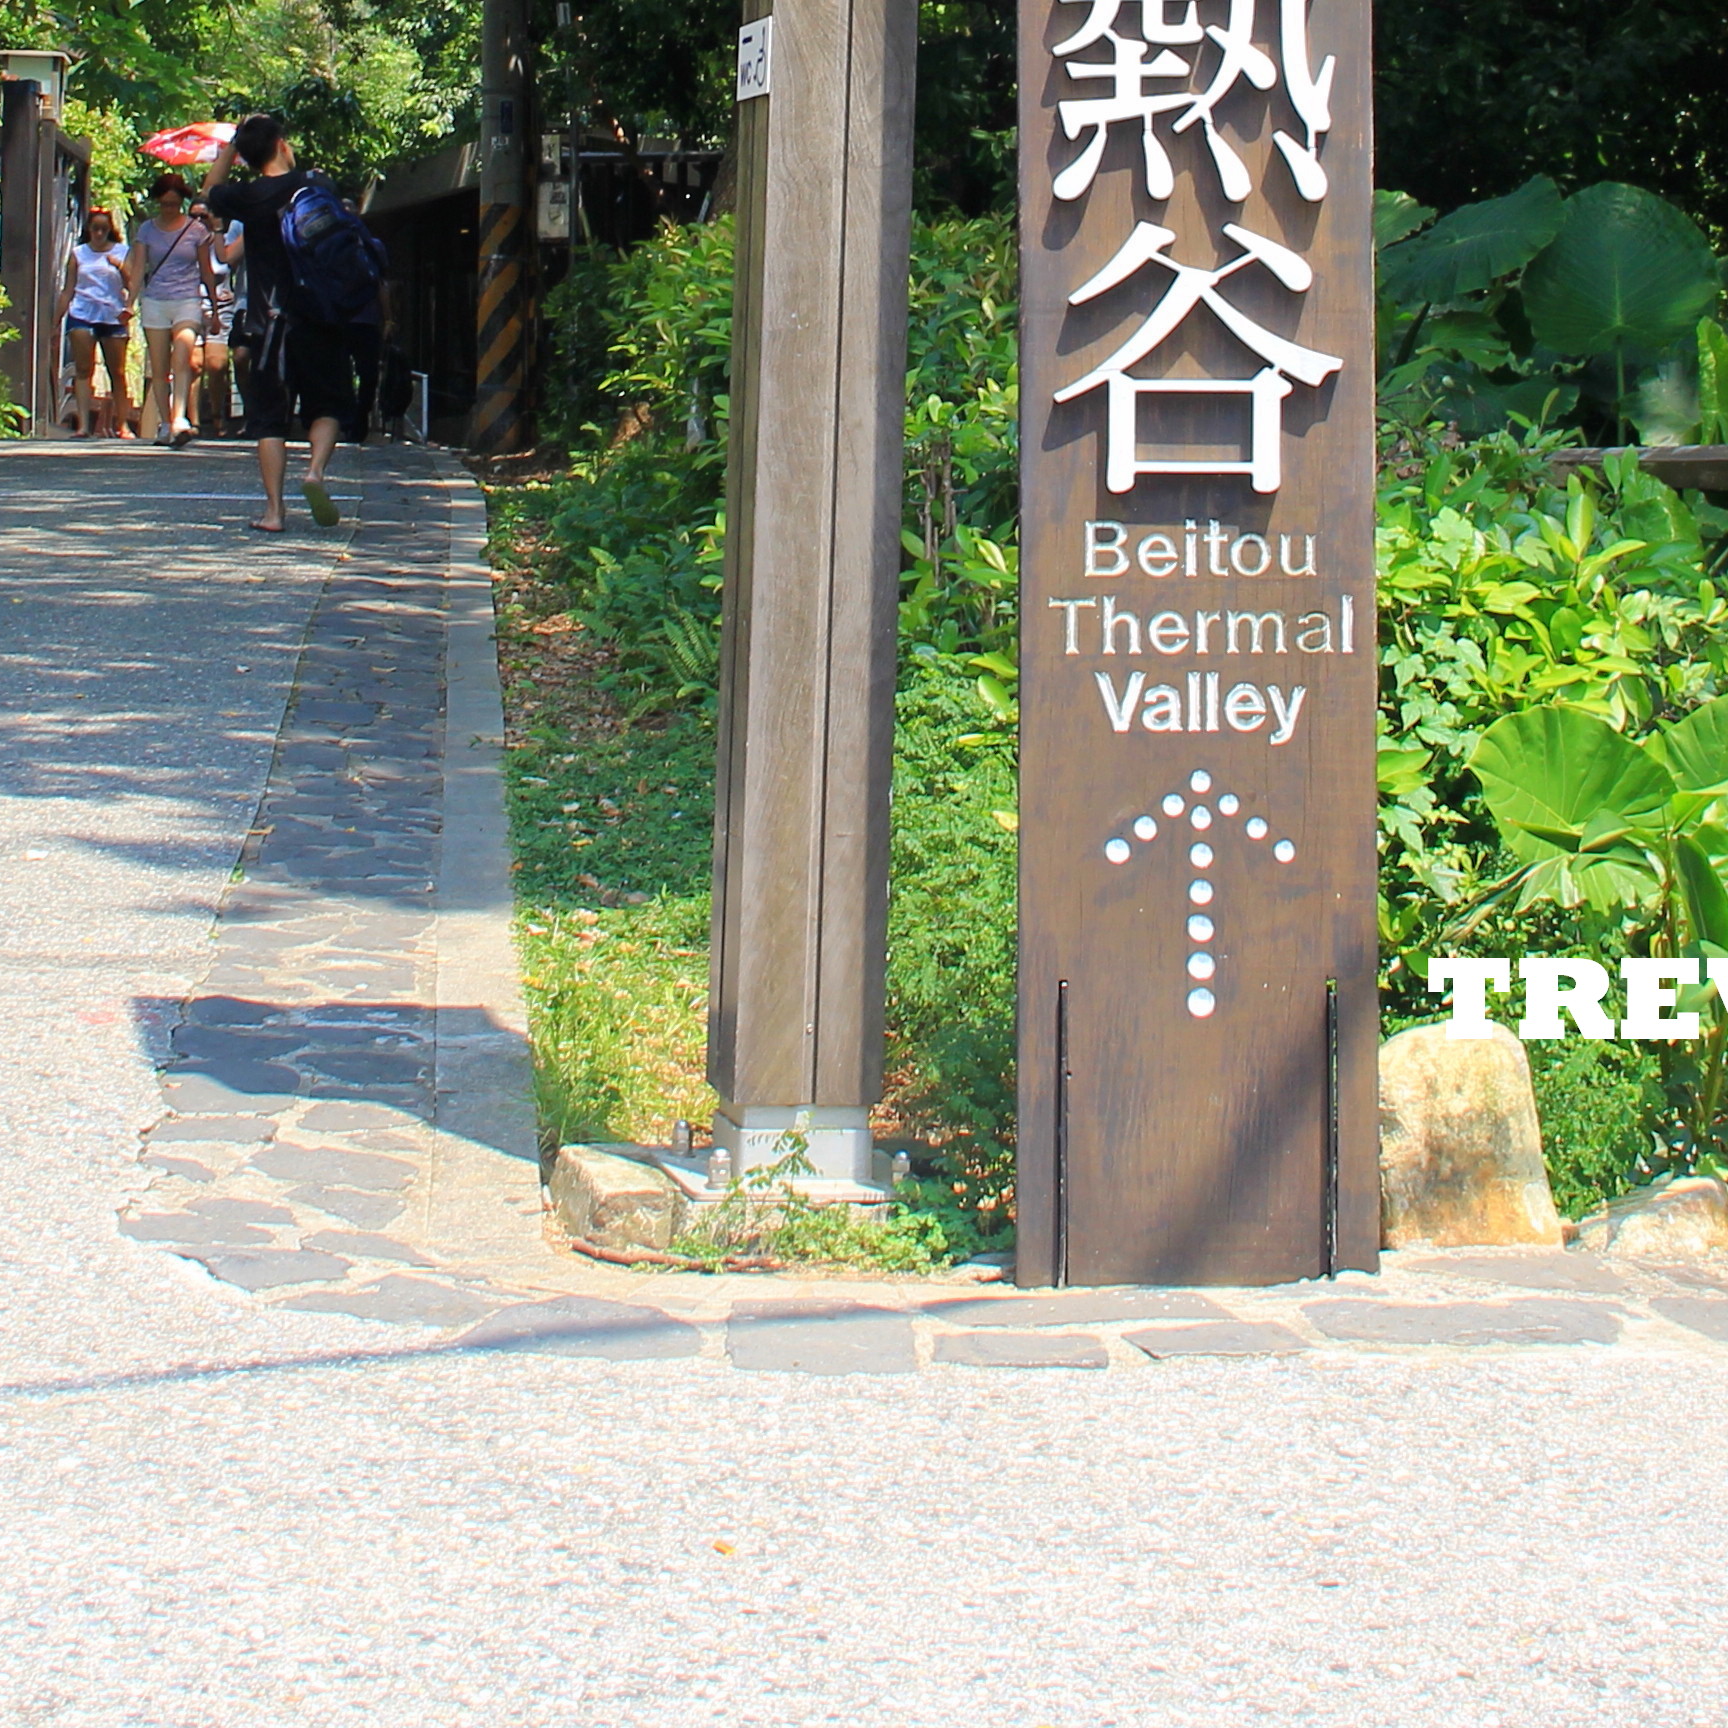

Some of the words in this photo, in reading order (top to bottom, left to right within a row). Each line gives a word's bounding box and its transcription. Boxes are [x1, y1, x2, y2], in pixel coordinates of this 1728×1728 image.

[1084, 519, 1318, 577] Beitou
[1048, 594, 1355, 655] Thermal
[1094, 671, 1307, 745] Valley
